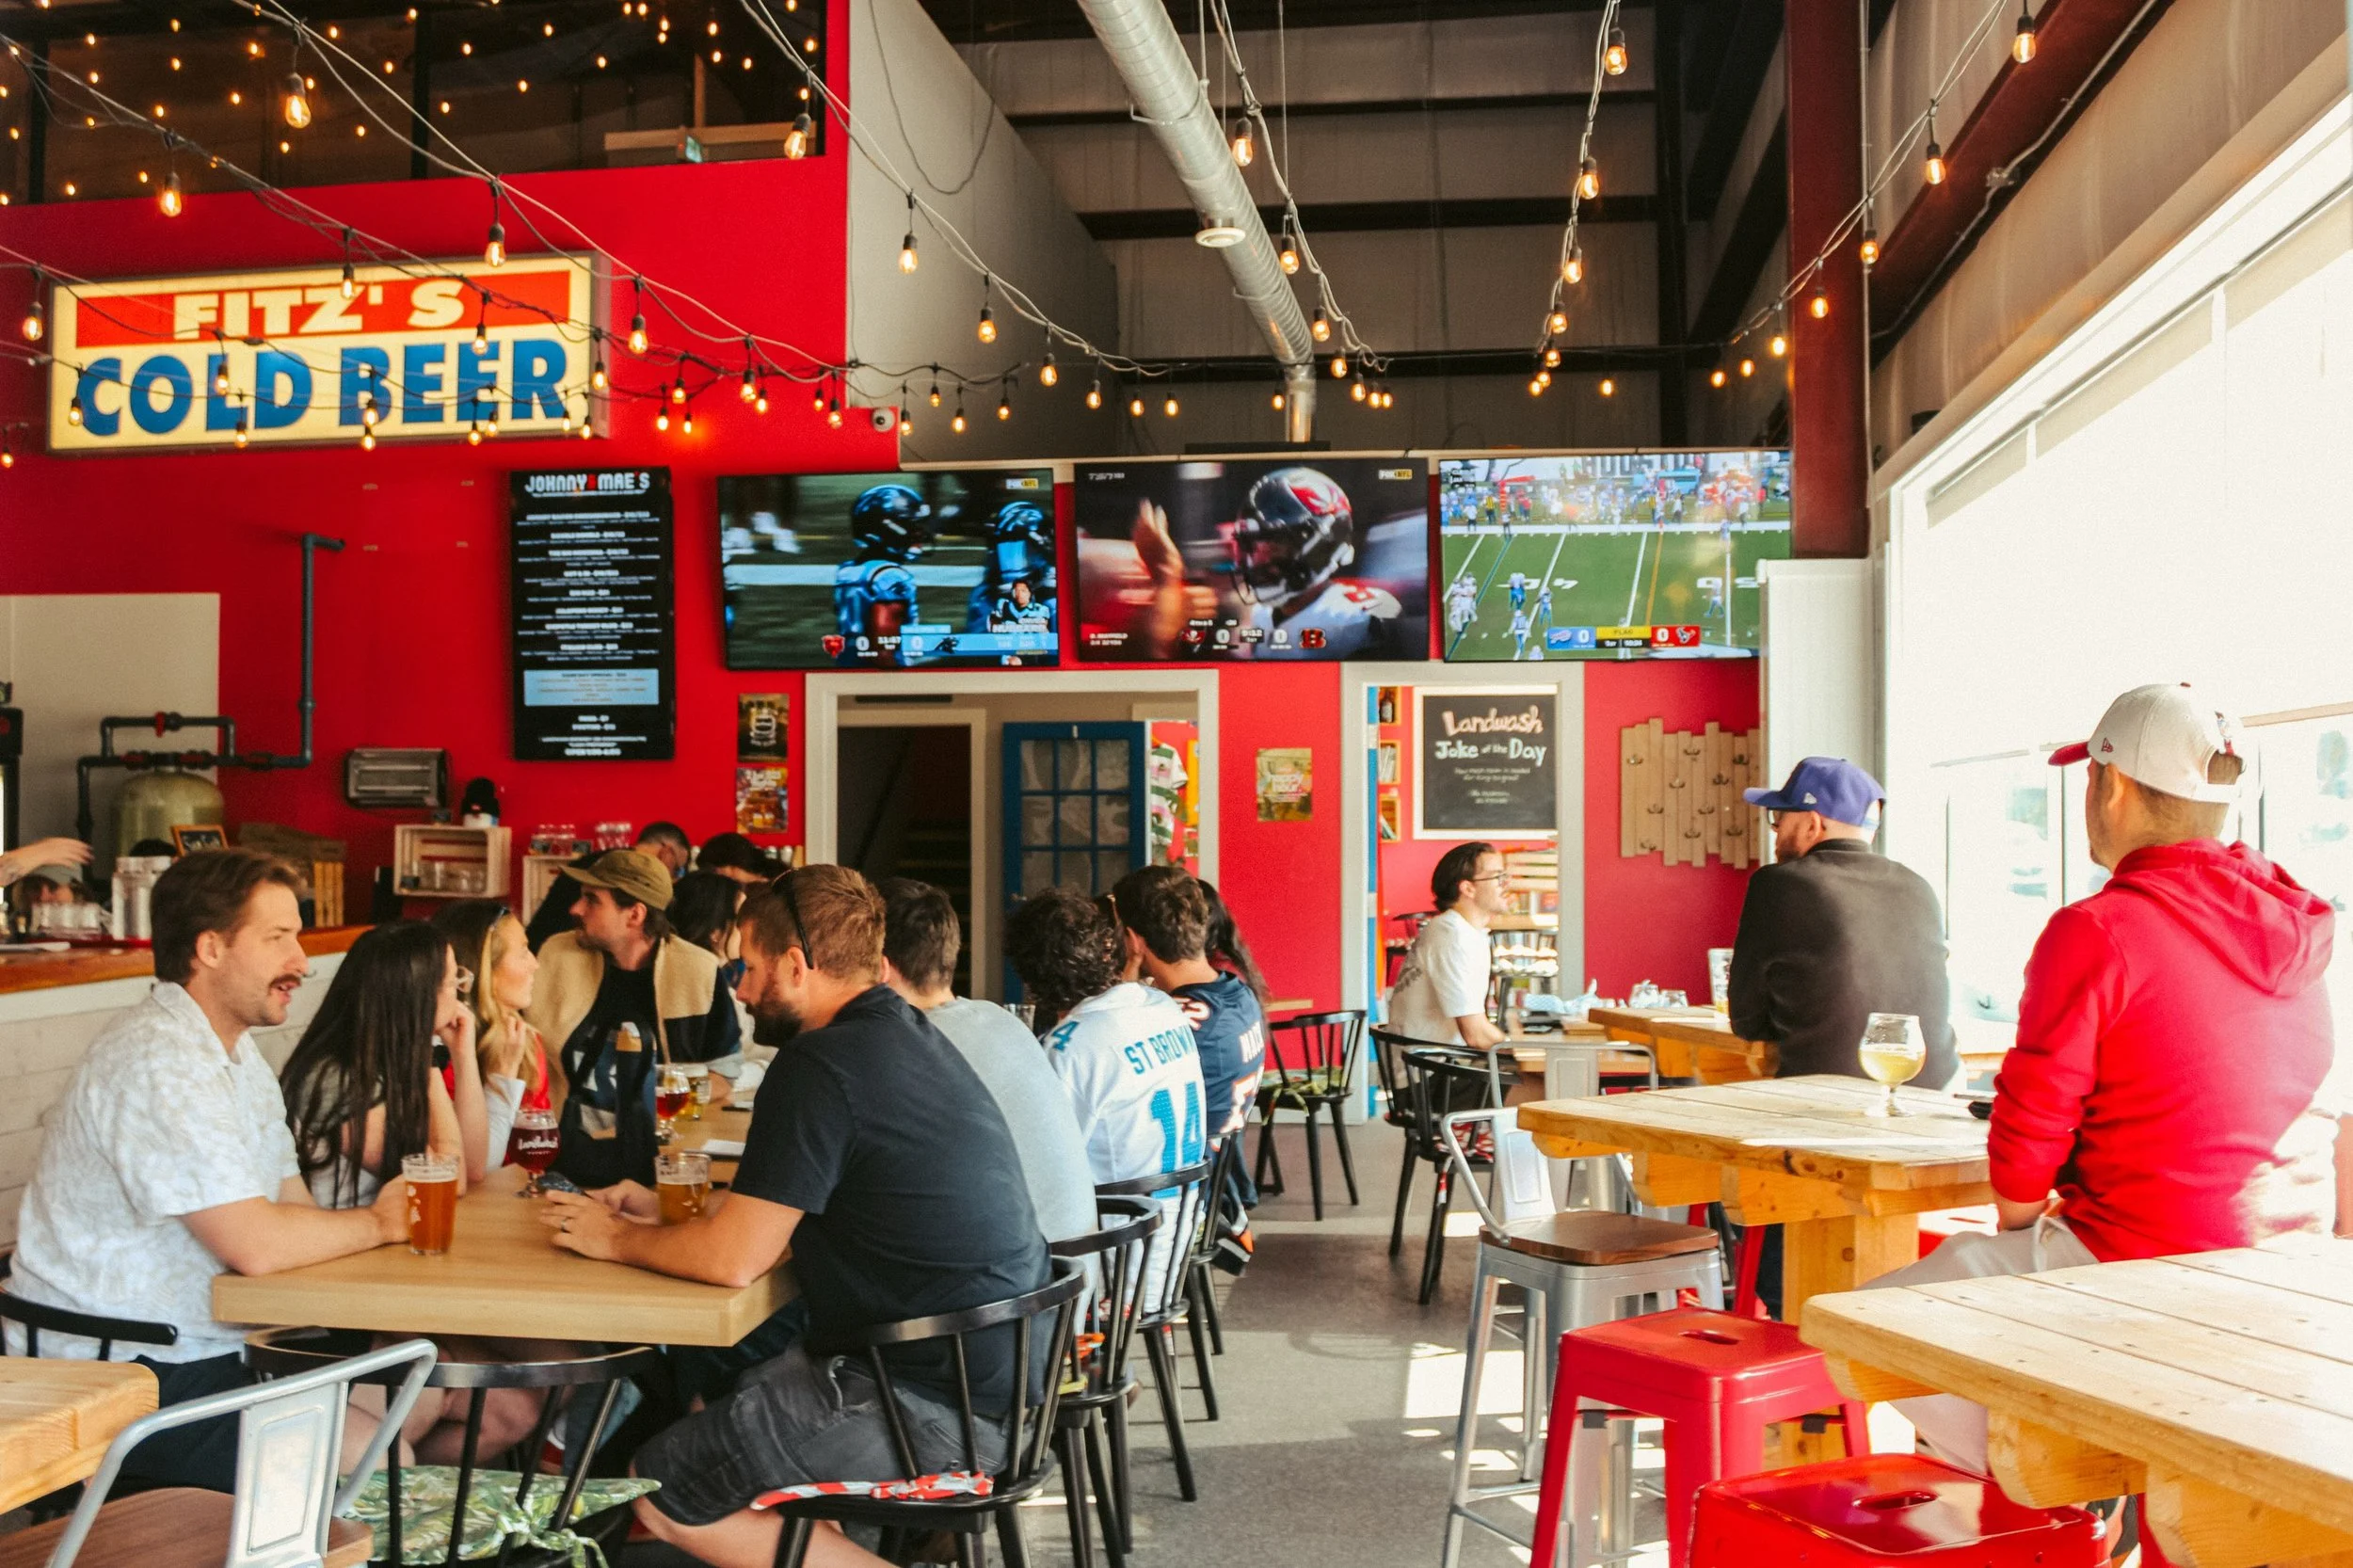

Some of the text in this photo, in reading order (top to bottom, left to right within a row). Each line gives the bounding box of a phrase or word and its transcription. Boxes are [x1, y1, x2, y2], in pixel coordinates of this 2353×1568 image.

[77, 339, 568, 437] COLD BEER
[524, 474, 587, 492] JOHNNY
[598, 472, 649, 490] MAE'S
[856, 636, 870, 651] 0
[1215, 629, 1230, 644] 0
[1273, 629, 1289, 644] 0
[1577, 630, 1590, 644] 0
[1657, 628, 1669, 643] 0
[1442, 705, 1544, 737] Landwash
[1434, 740, 1479, 760] Joke
[1509, 738, 1547, 767] Day
[1124, 1041, 1153, 1075] ST
[1149, 1080, 1203, 1199] 14
